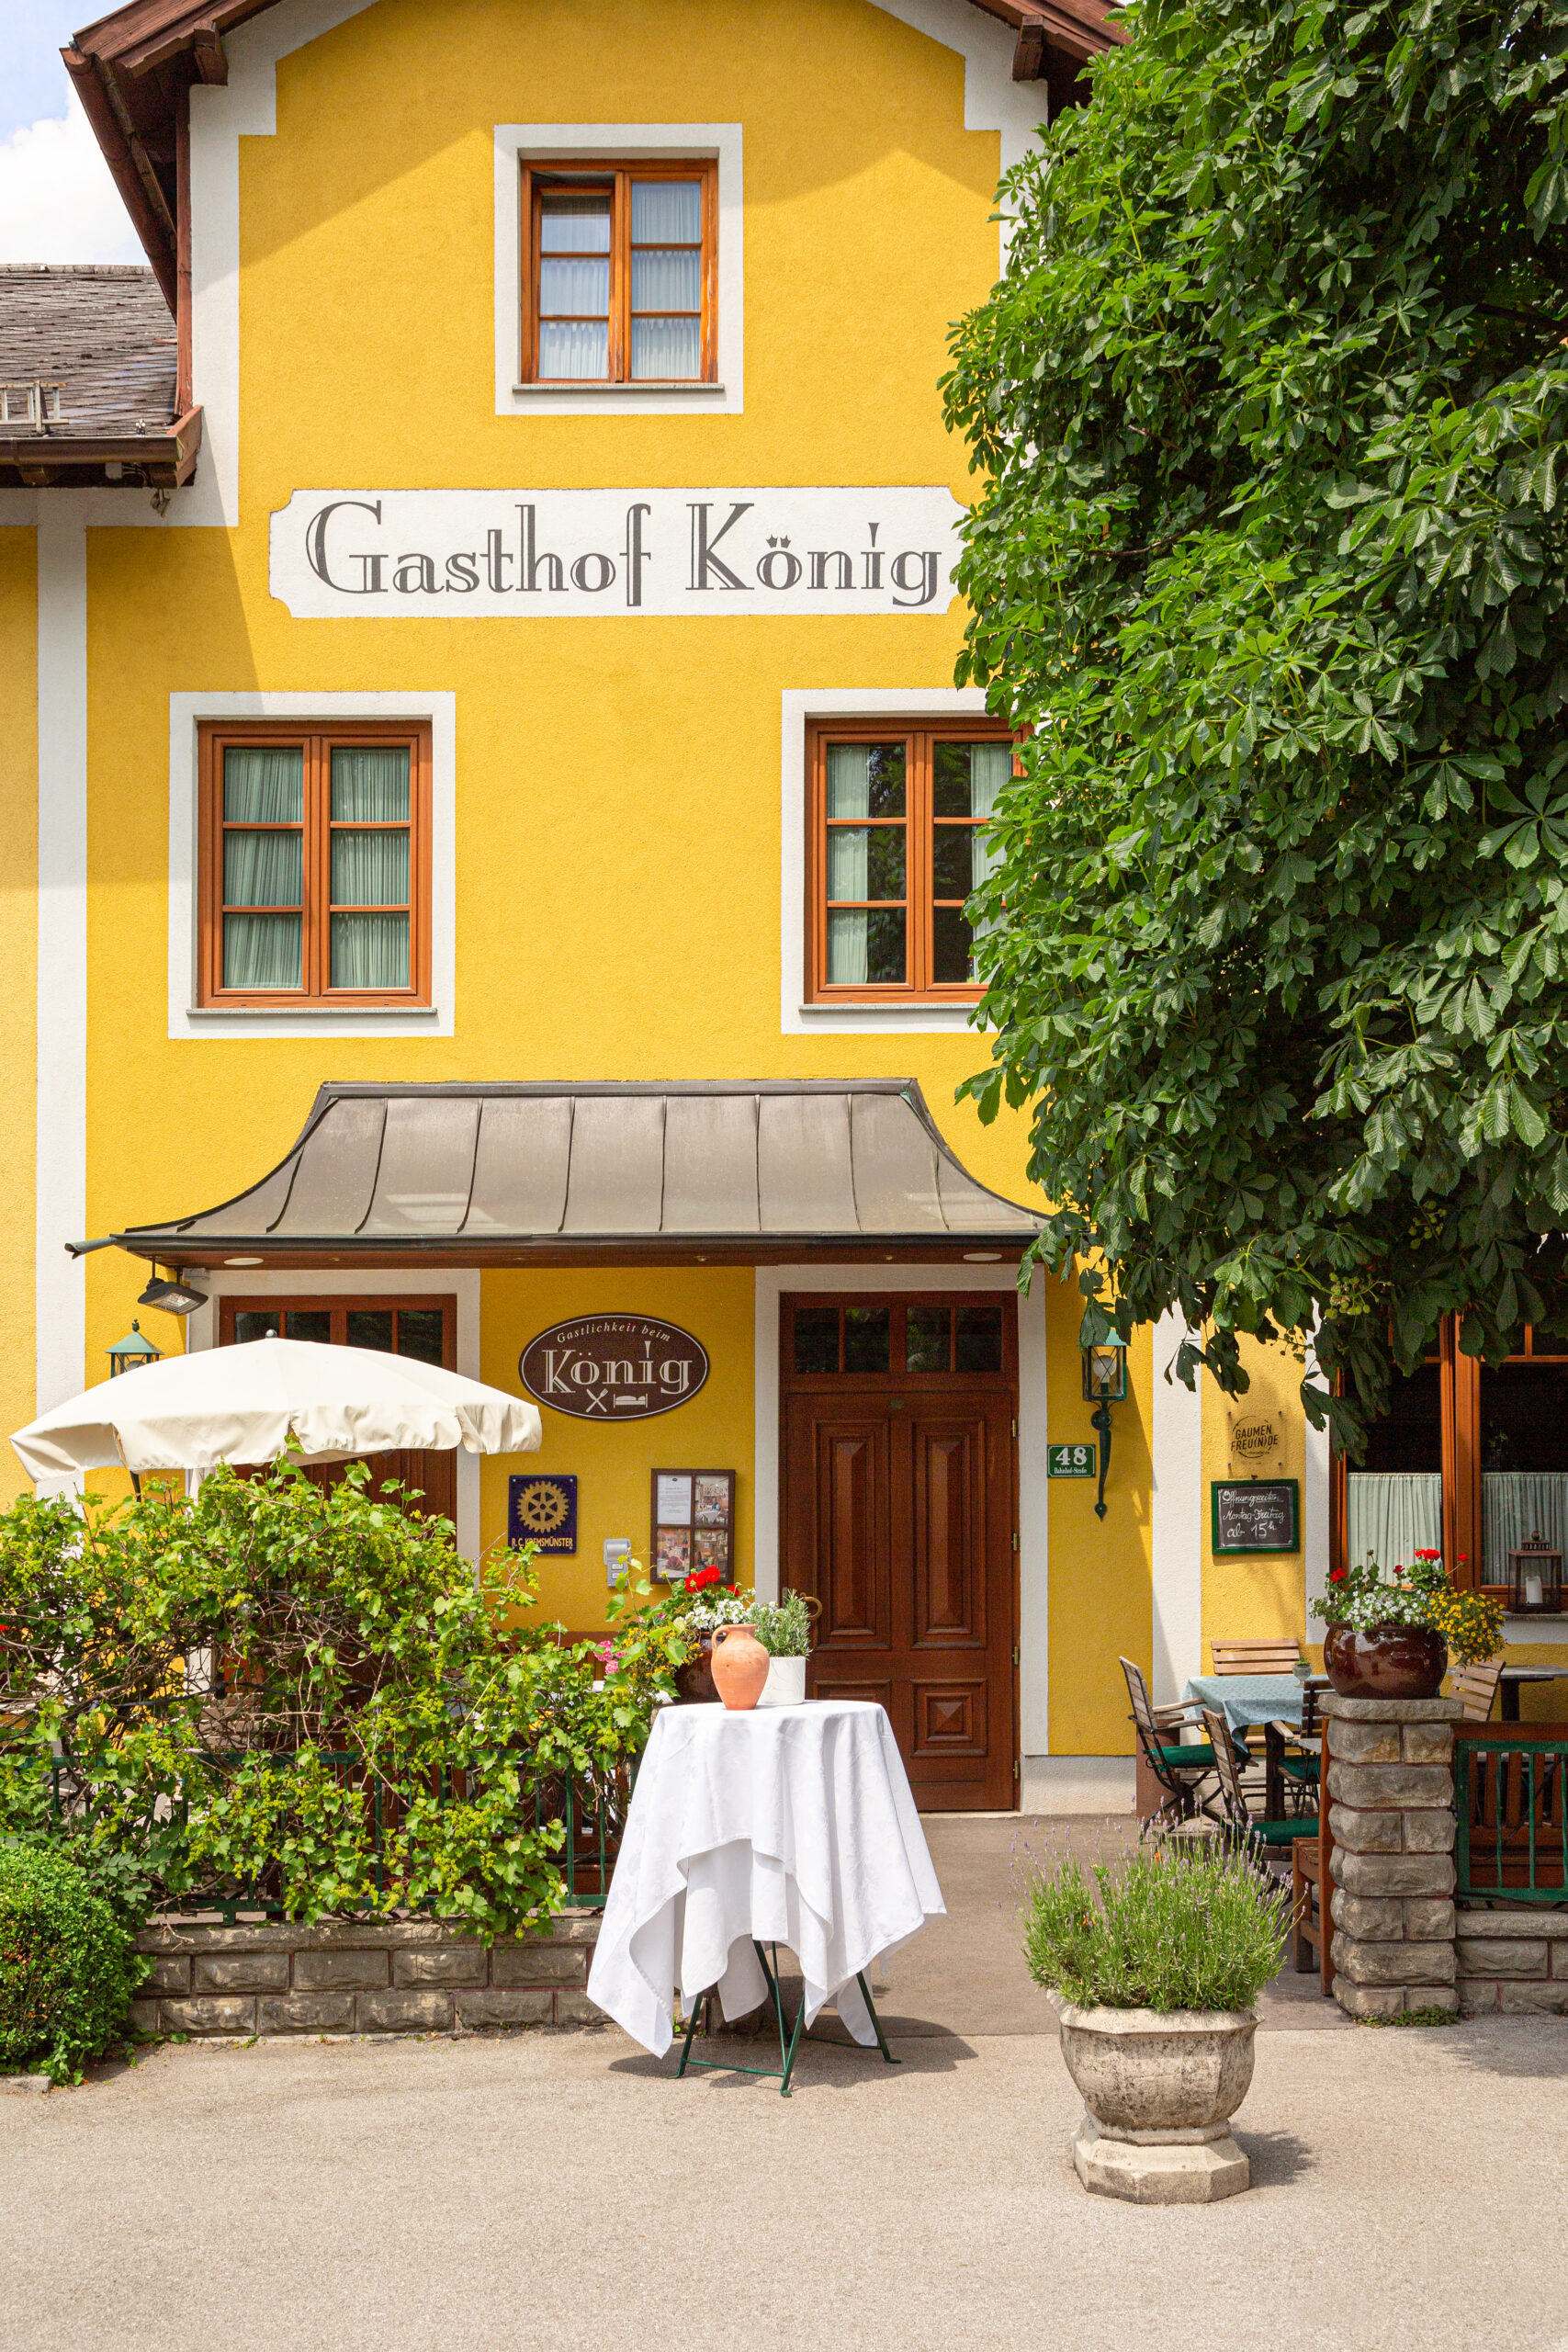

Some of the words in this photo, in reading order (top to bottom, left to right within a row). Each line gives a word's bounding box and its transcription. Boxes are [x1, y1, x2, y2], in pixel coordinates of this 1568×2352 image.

[305, 500, 651, 607] Gasthof
[685, 503, 942, 606] König
[557, 1322, 637, 1343] Gastlichkeit
[642, 1325, 671, 1341] beim
[541, 1340, 694, 1395] König
[1235, 1424, 1272, 1440] GAUMEN
[1231, 1434, 1279, 1452] FREU(N)DE
[1055, 1447, 1088, 1465] 48
[1226, 1522, 1245, 1538] ab
